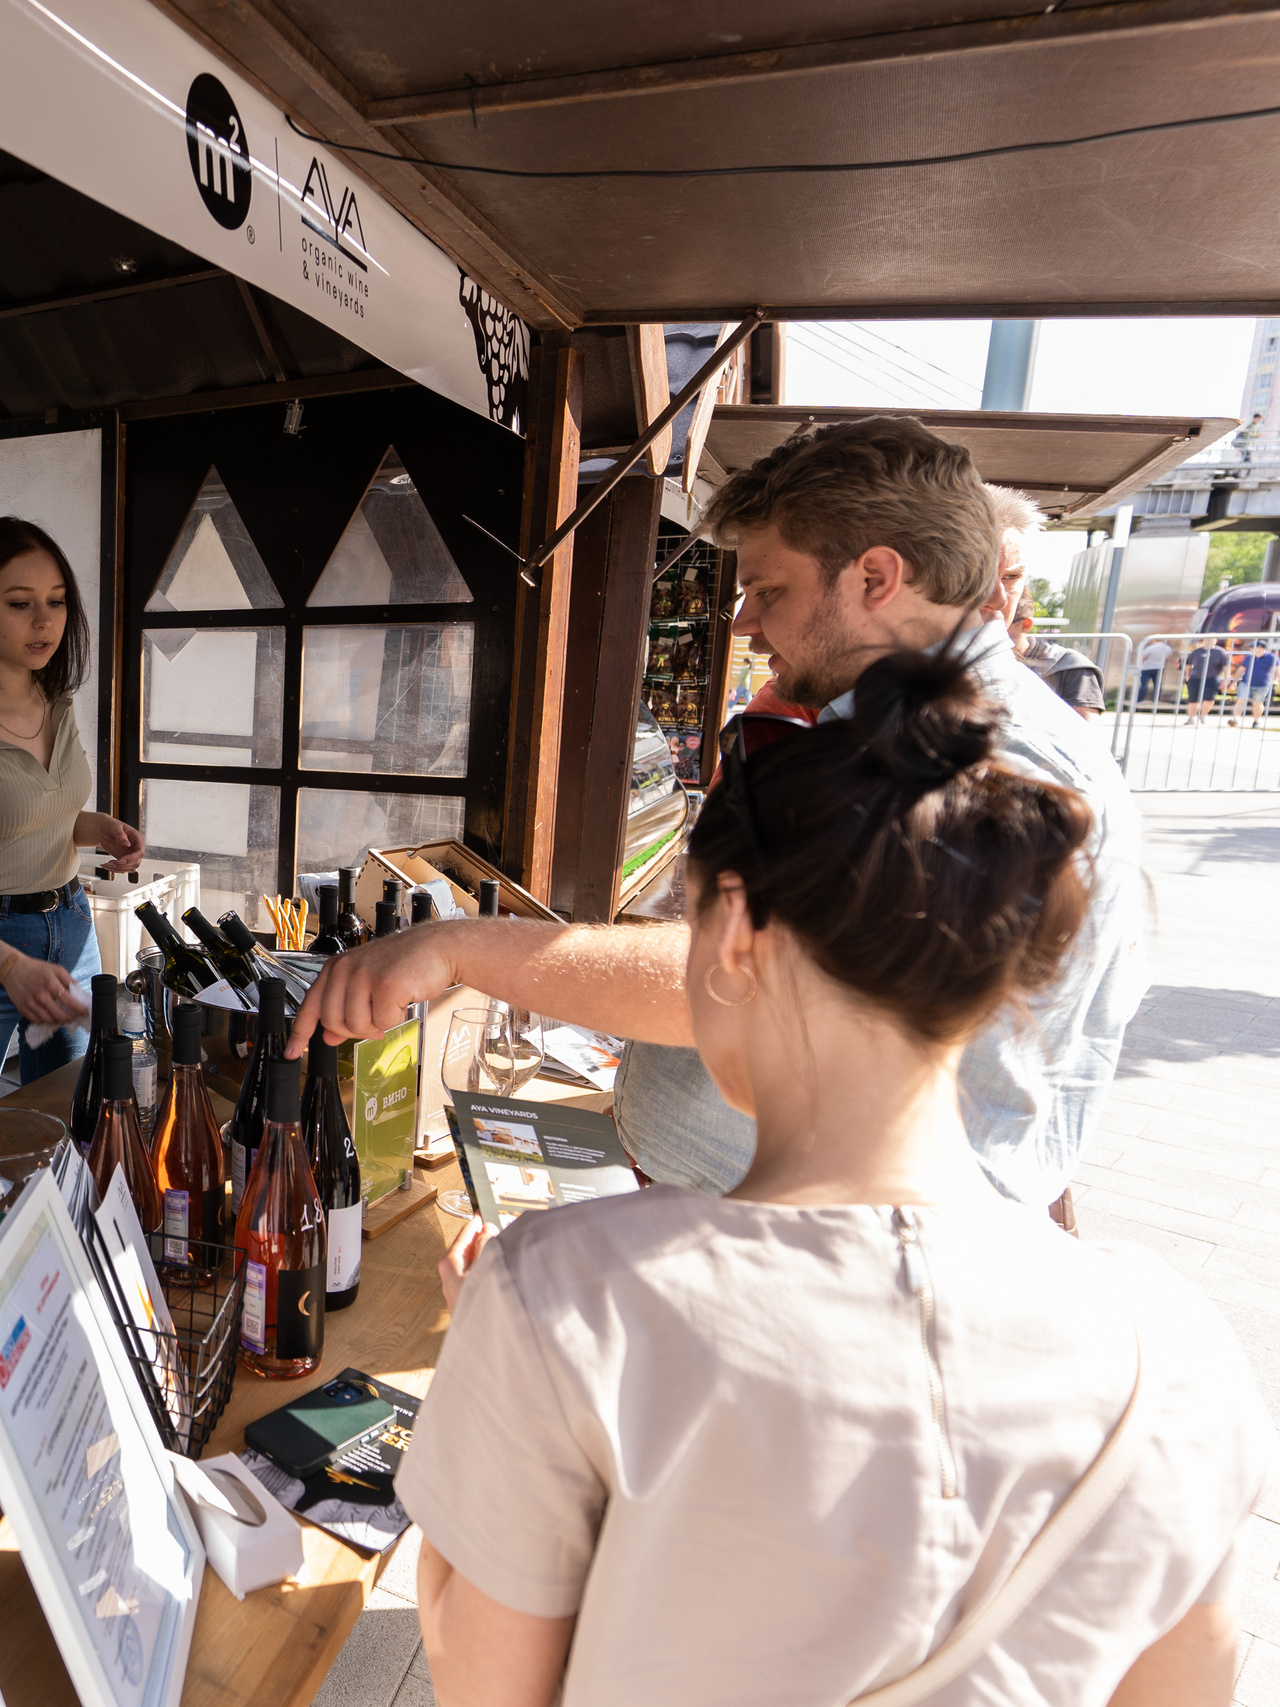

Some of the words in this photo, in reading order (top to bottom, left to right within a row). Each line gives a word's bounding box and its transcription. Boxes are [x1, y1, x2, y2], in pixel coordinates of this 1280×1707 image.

[301, 237, 344, 280] organic
[348, 267, 370, 298] wine
[302, 260, 311, 281] &
[315, 270, 365, 319] vineyards
[382, 1086, 407, 1110] ВИНО
[470, 1104, 488, 1114] AYA
[489, 1106, 539, 1120] VINEYARDS
[300, 1197, 322, 1232] 18
